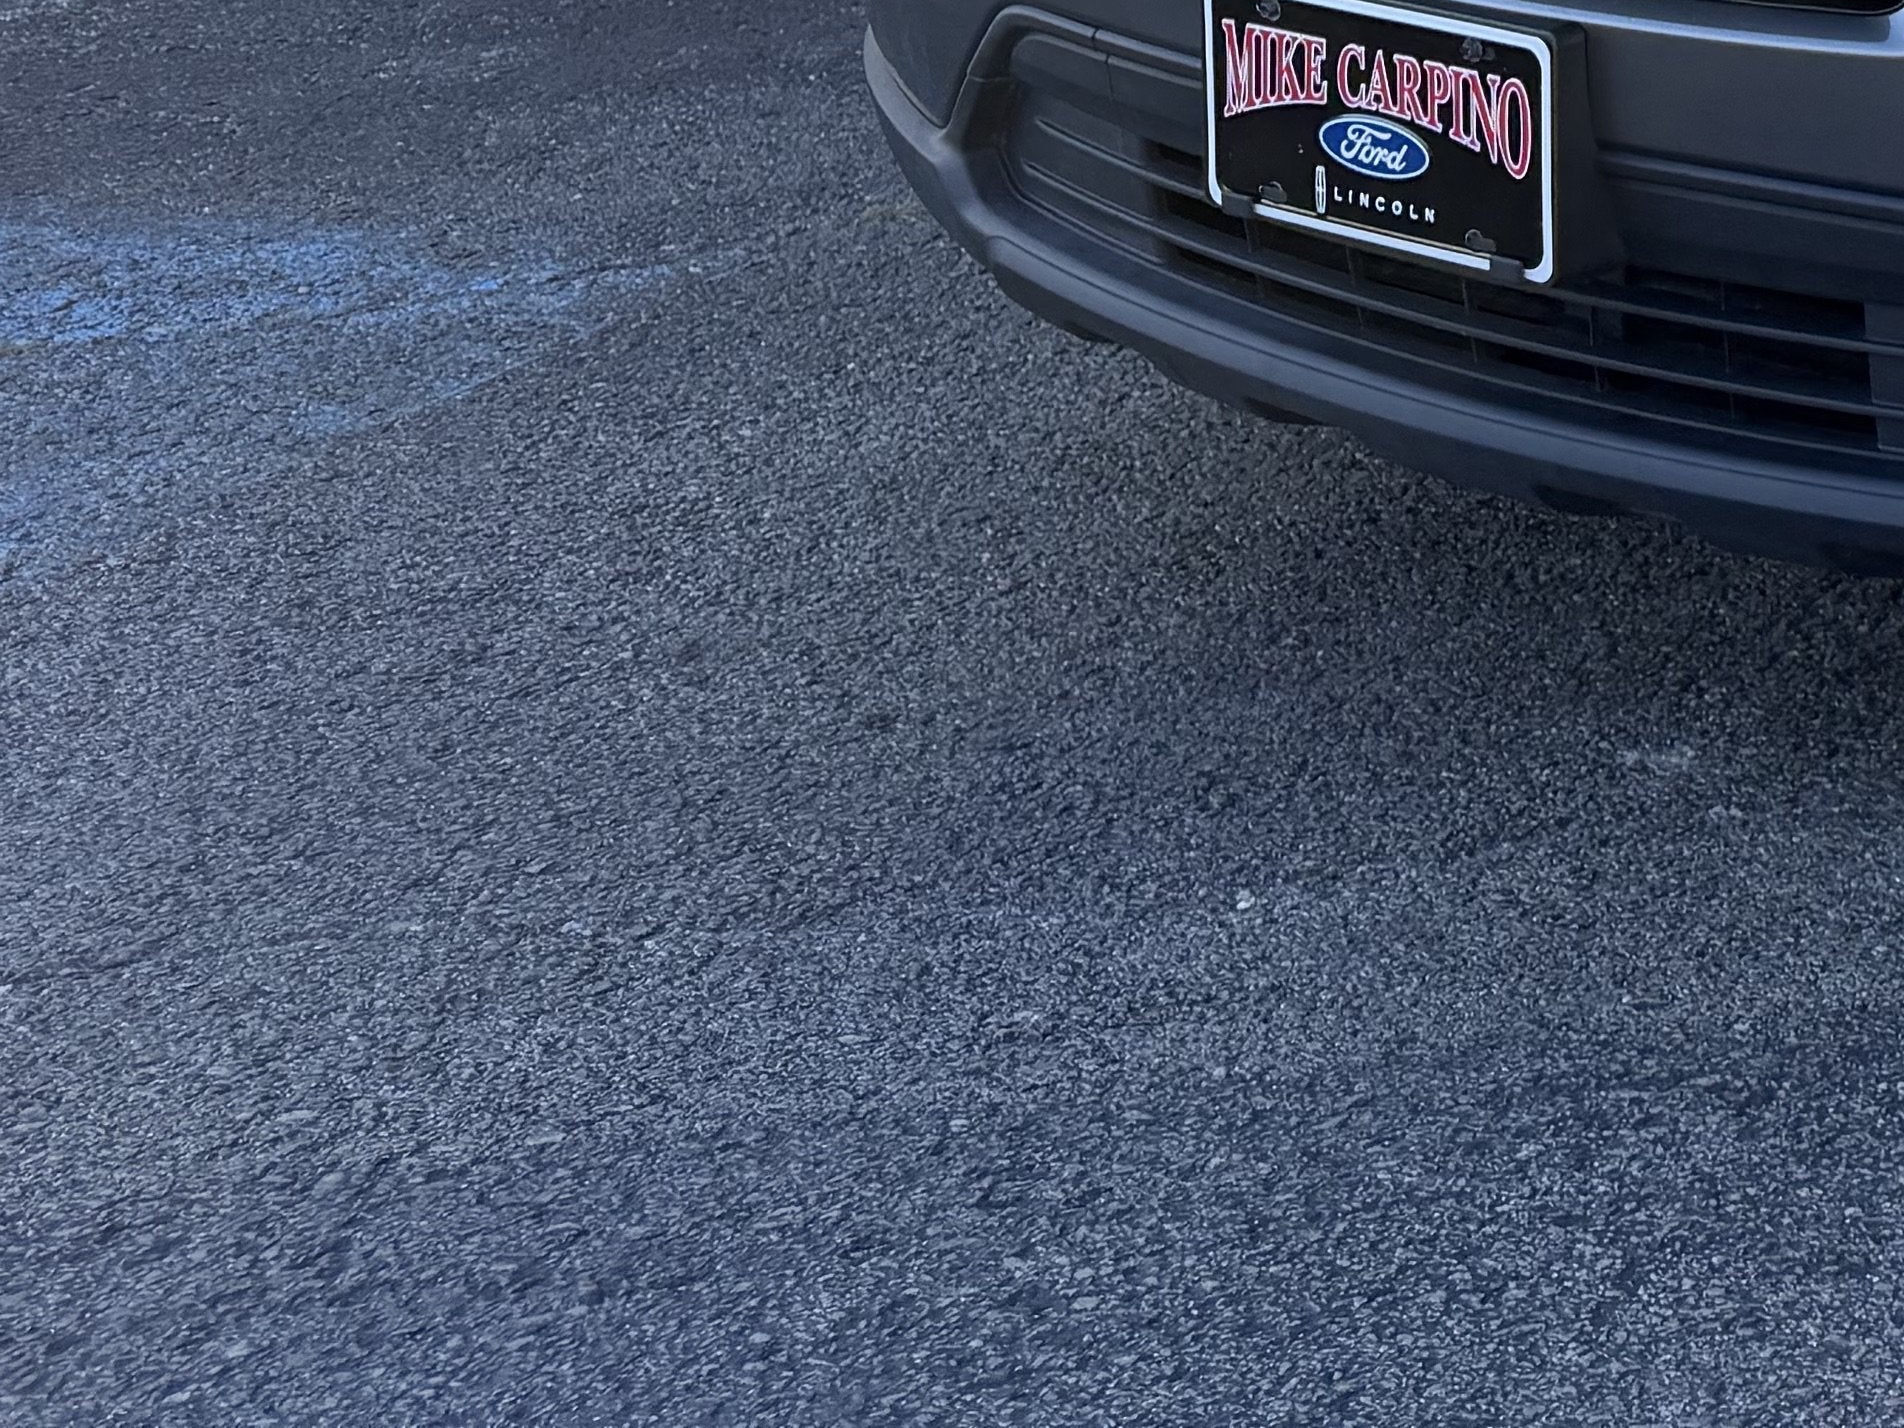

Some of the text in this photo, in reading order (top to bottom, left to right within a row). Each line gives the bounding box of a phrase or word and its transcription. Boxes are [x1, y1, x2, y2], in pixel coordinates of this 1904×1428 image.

[1221, 18, 1532, 179] MIKE CARPINO
[1341, 123, 1408, 172] Ford
[1334, 187, 1435, 223] LINCOLN
